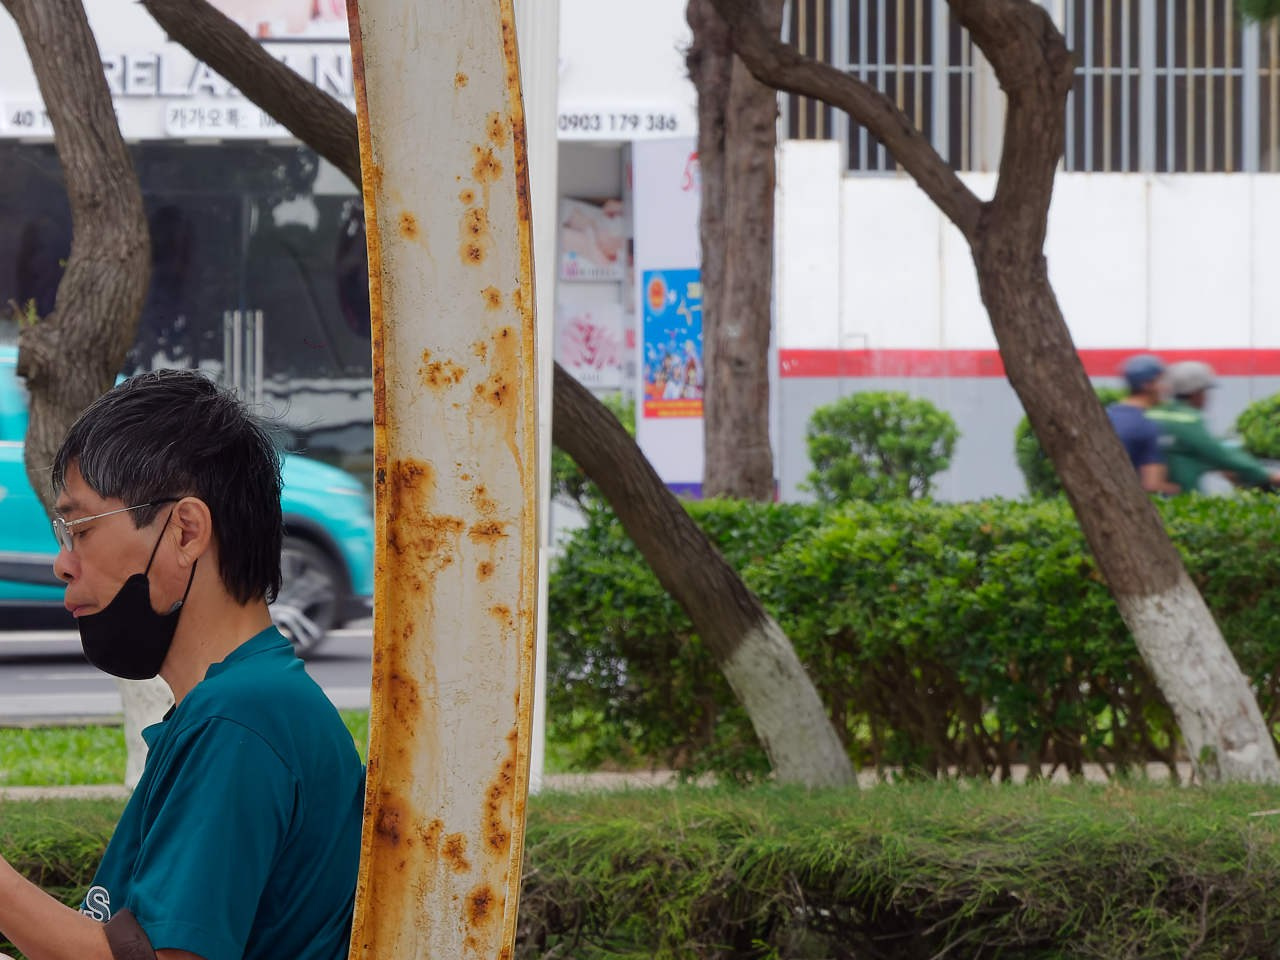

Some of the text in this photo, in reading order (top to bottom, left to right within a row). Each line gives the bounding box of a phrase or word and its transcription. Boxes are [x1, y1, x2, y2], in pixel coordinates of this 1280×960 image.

[557, 113, 677, 131] 0903 179 386
